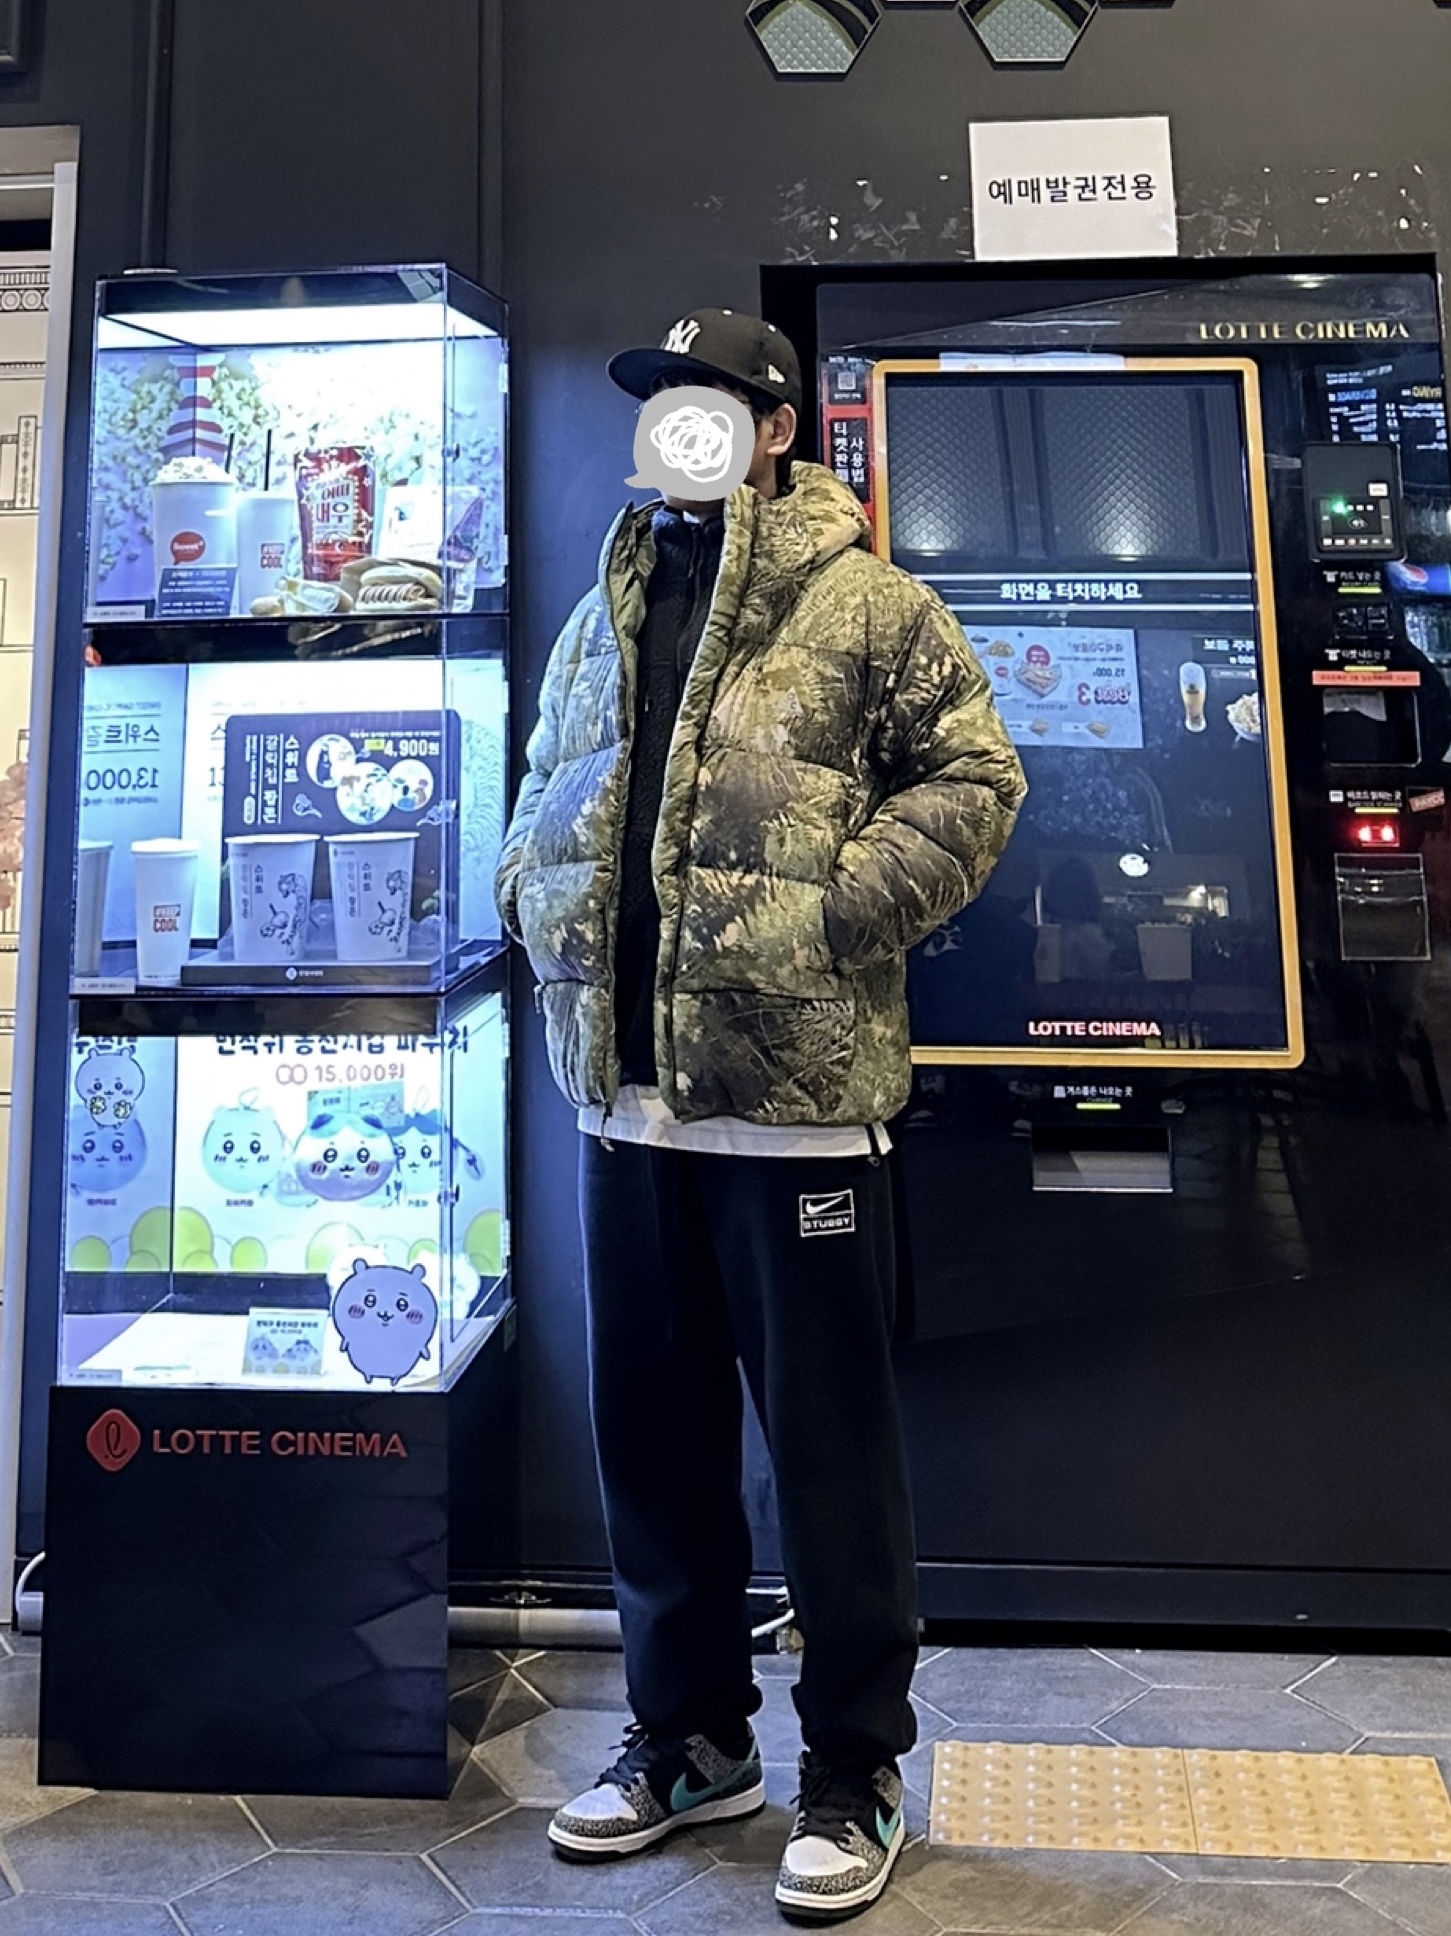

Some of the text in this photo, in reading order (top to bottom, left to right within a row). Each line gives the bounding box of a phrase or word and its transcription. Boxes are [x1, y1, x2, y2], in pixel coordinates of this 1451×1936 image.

[988, 173, 1157, 205] 예매발권전용
[663, 319, 701, 354] NY
[1199, 321, 1410, 340] LOTTE CINEMA
[1000, 582, 1142, 601] 화면을 터치하세요
[284, 735, 300, 783] 스위트
[153, 918, 179, 932] COOL
[1028, 1021, 1161, 1036] LOTTE CINEMA
[152, 1429, 407, 1458] LOTTE CINEMA
